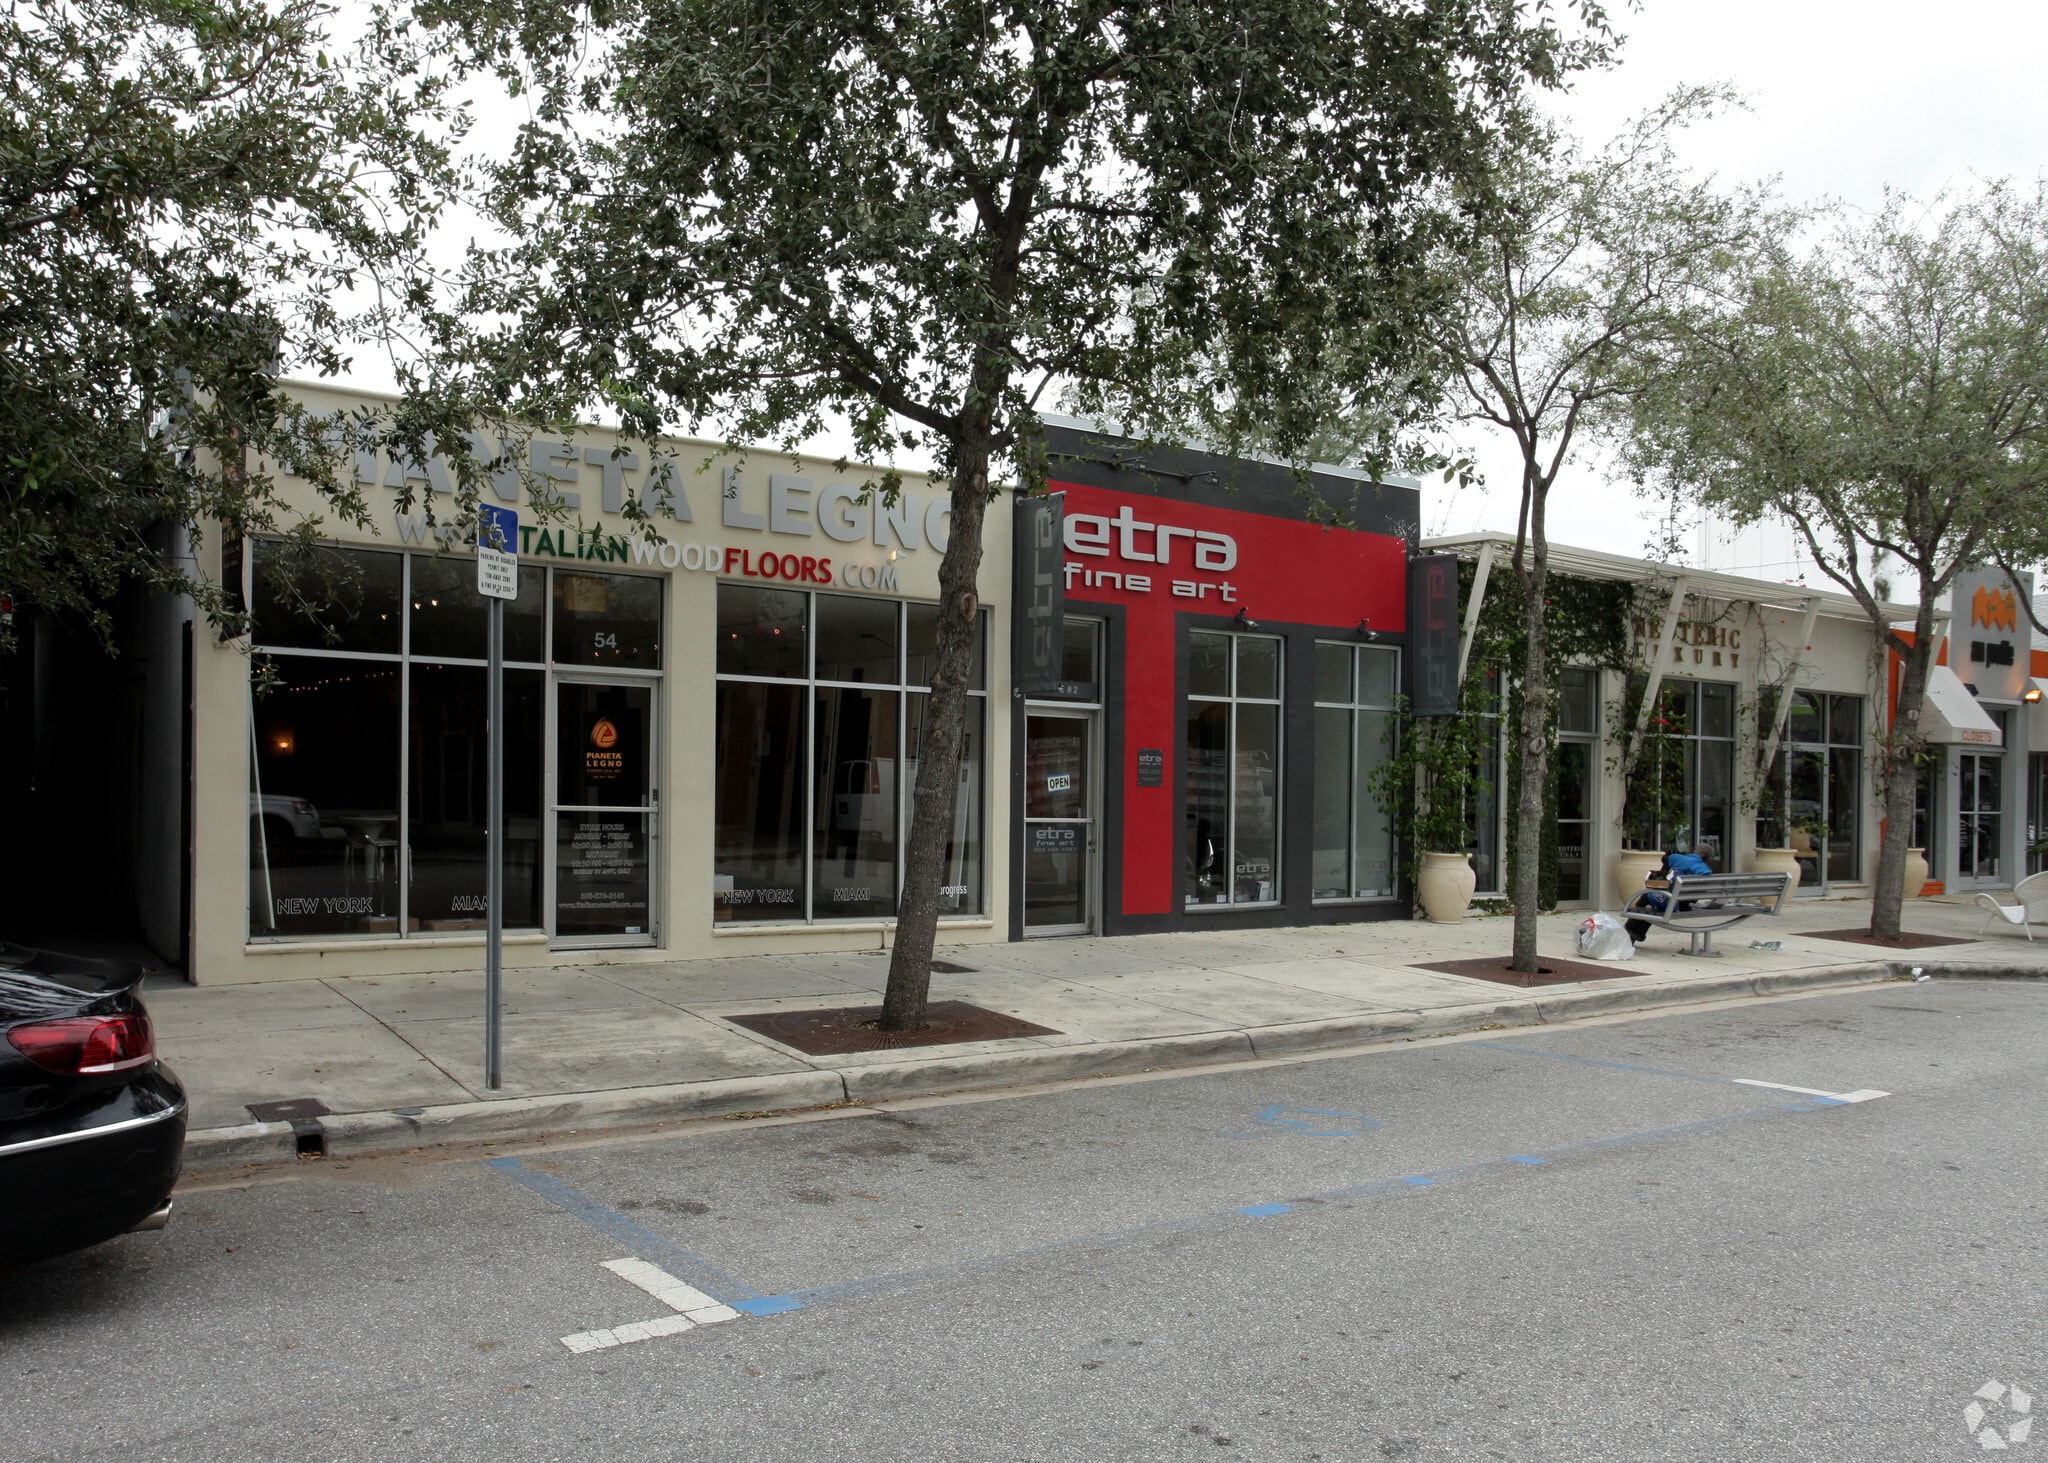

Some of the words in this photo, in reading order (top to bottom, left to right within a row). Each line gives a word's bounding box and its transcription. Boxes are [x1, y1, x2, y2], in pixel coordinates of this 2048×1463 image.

[1063, 505, 1237, 572] etra
[480, 553, 494, 561] PARKING
[501, 557, 515, 565] DISABLED
[1063, 562, 1151, 592] fine
[1172, 579, 1237, 602] art
[594, 632, 618, 649] 54
[1632, 616, 1741, 650] NETERIC
[586, 752, 622, 760] PIANETA
[586, 760, 623, 768] LEGNO
[1049, 777, 1069, 790] OPEN
[602, 823, 625, 831] HOURS
[1036, 827, 1075, 839] etra
[1236, 862, 1270, 873] etra
[722, 889, 754, 904] NEW
[756, 888, 795, 903] YORK
[833, 887, 872, 902] MIAMI
[277, 897, 320, 914] NEW
[322, 896, 374, 913] YORK
[452, 895, 489, 911] MIA
